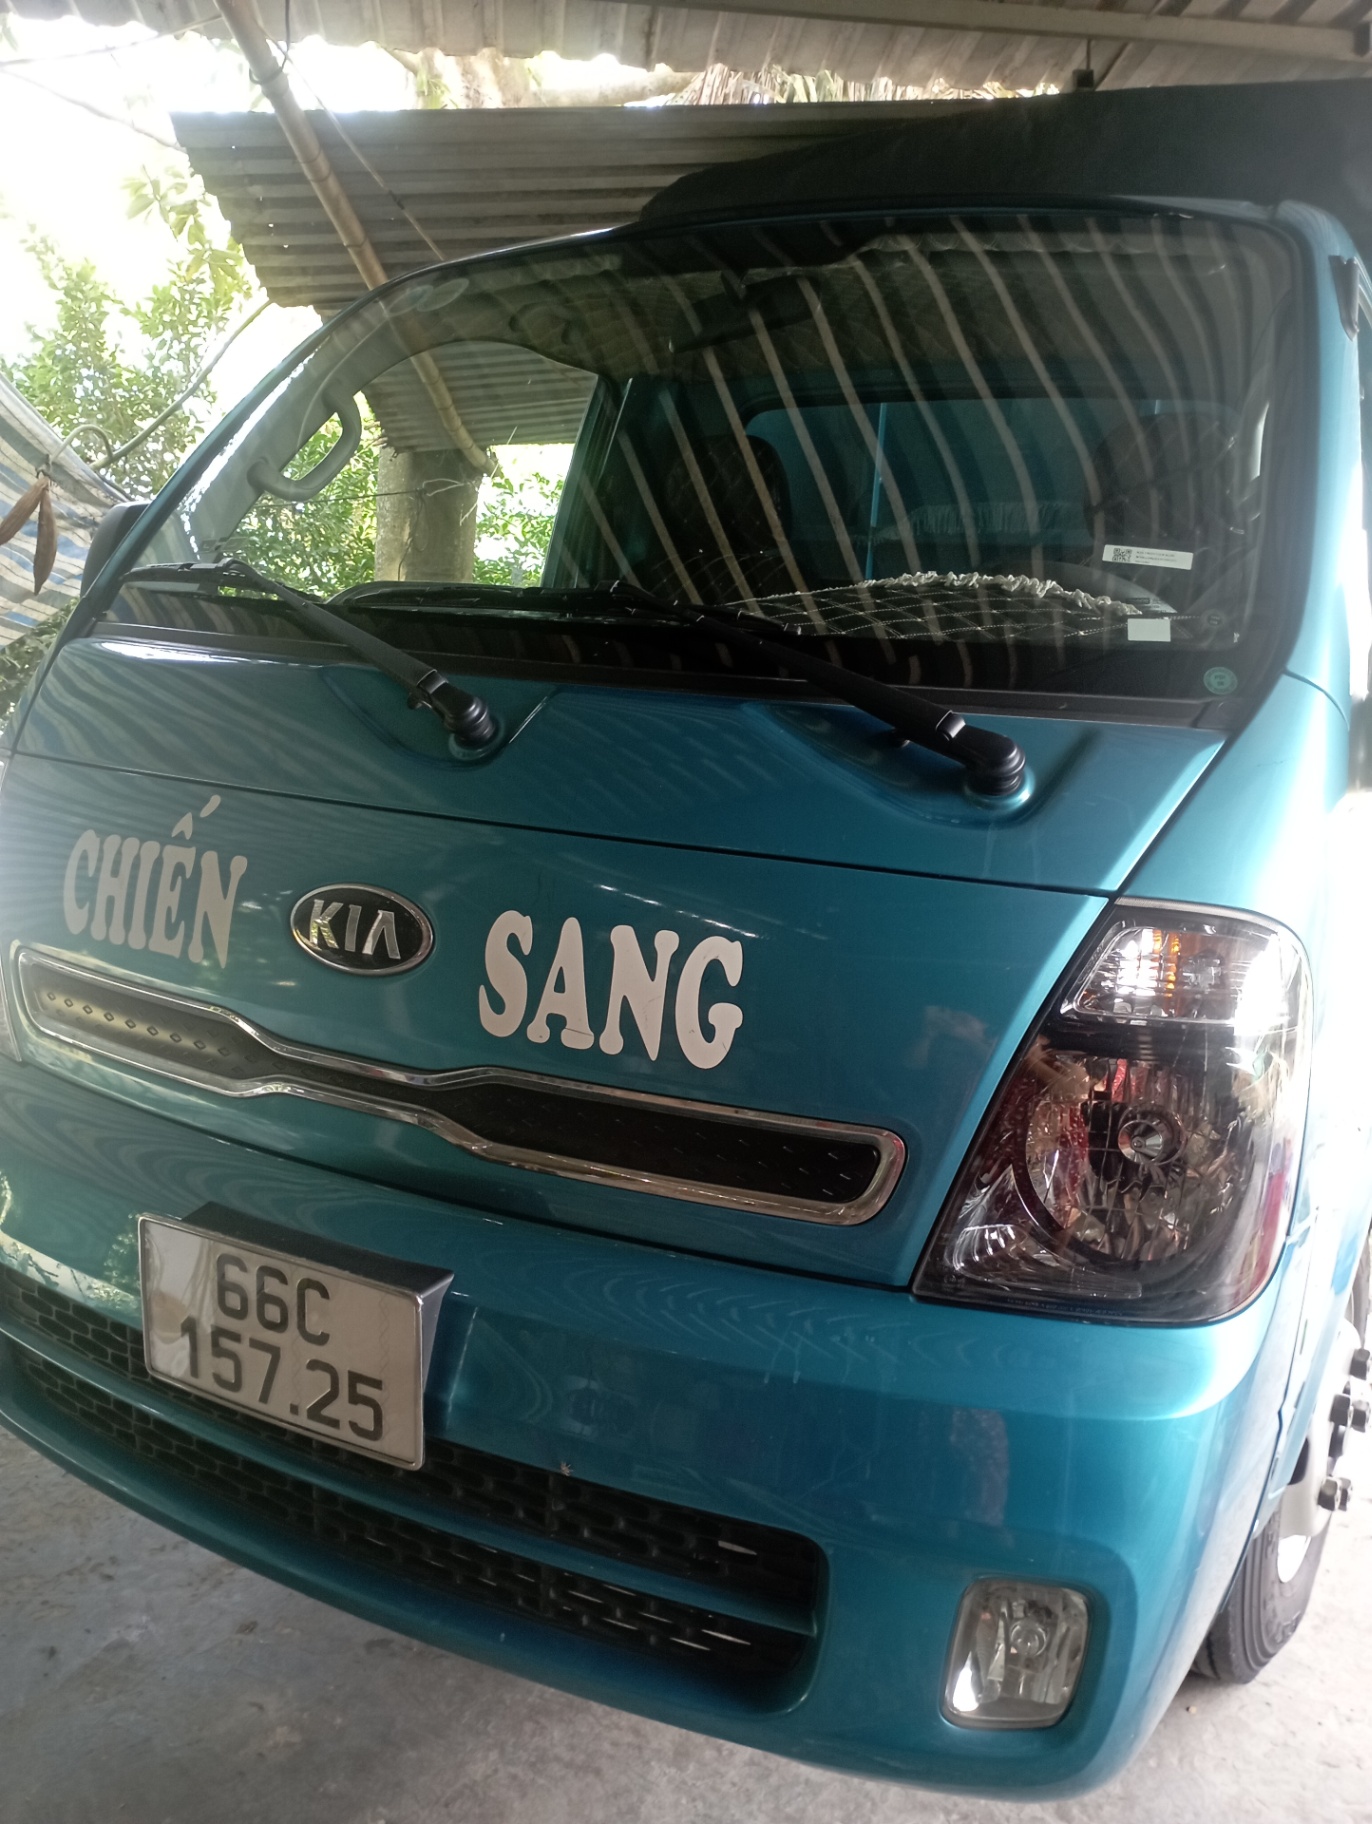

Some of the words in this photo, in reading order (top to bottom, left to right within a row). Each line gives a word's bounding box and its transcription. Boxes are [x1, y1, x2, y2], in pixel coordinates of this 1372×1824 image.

[64, 795, 248, 969] CHIẾN
[310, 899, 401, 960] KIA
[479, 910, 743, 1069] SANG
[216, 1253, 330, 1346] 66C
[181, 1315, 383, 1442] 157.25
